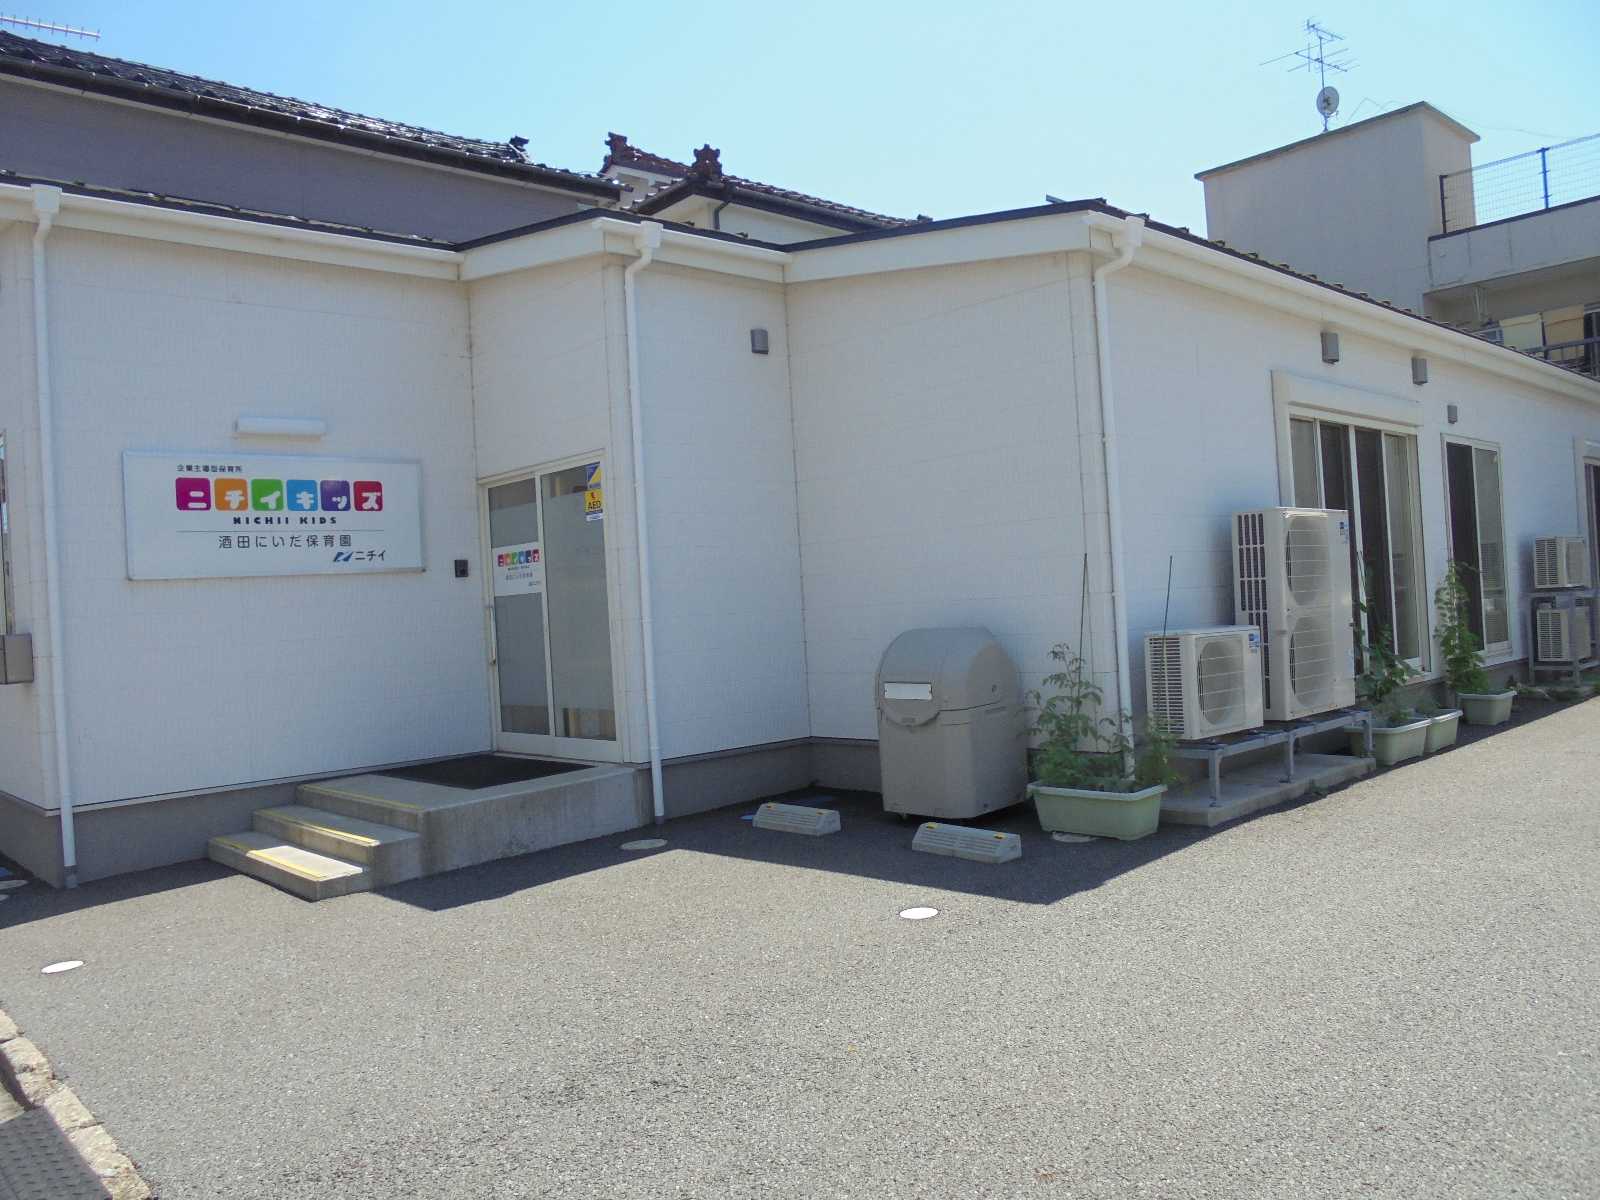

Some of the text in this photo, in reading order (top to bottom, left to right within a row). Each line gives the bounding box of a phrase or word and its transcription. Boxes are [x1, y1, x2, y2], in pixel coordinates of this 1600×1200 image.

[184, 487, 382, 511] ニチイキッズ
[233, 516, 337, 525] NICHII KIDS
[218, 535, 352, 549] 酒田にいだ保育園
[354, 550, 386, 561] ニチイ
